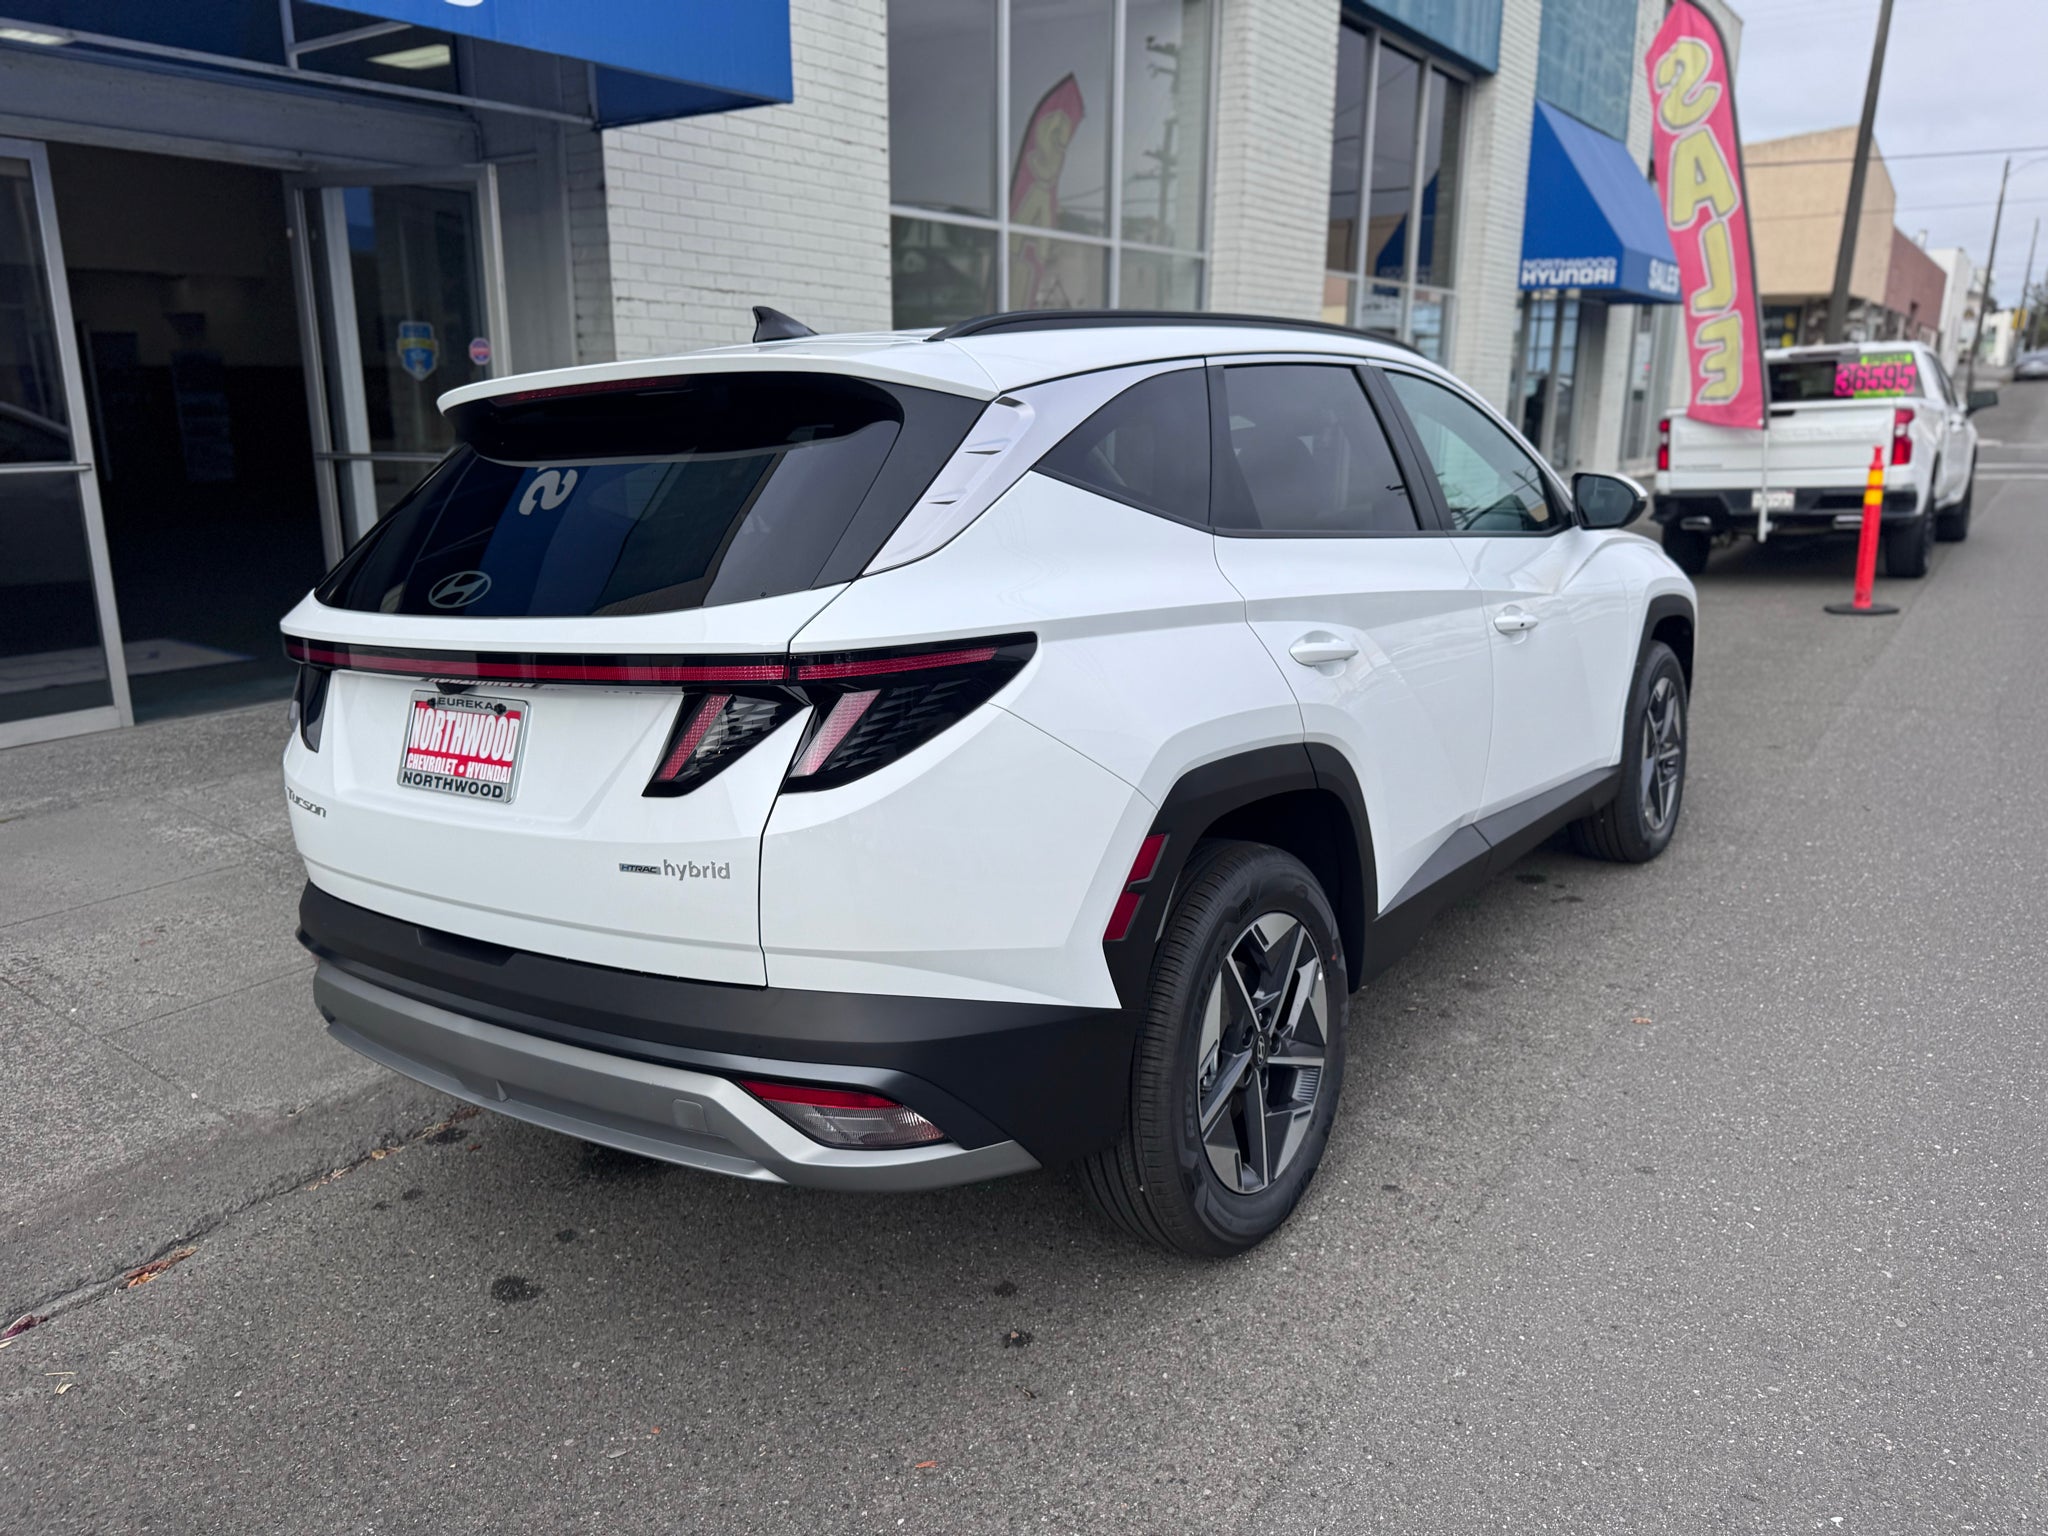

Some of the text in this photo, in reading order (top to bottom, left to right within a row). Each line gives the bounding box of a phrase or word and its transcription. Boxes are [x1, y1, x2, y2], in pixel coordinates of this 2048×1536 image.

[1522, 257, 1618, 270] NORTHWOOD
[1521, 267, 1617, 285] HYUNDAI
[1648, 258, 1681, 296] SALES
[1836, 362, 1914, 393] 36595
[438, 697, 495, 711] EUREKA
[410, 706, 520, 762] NORTHWOOD
[406, 752, 458, 776] CHEVROLET
[402, 771, 504, 799] NORTHWOOD
[620, 859, 731, 881] HTRAC hybrid
